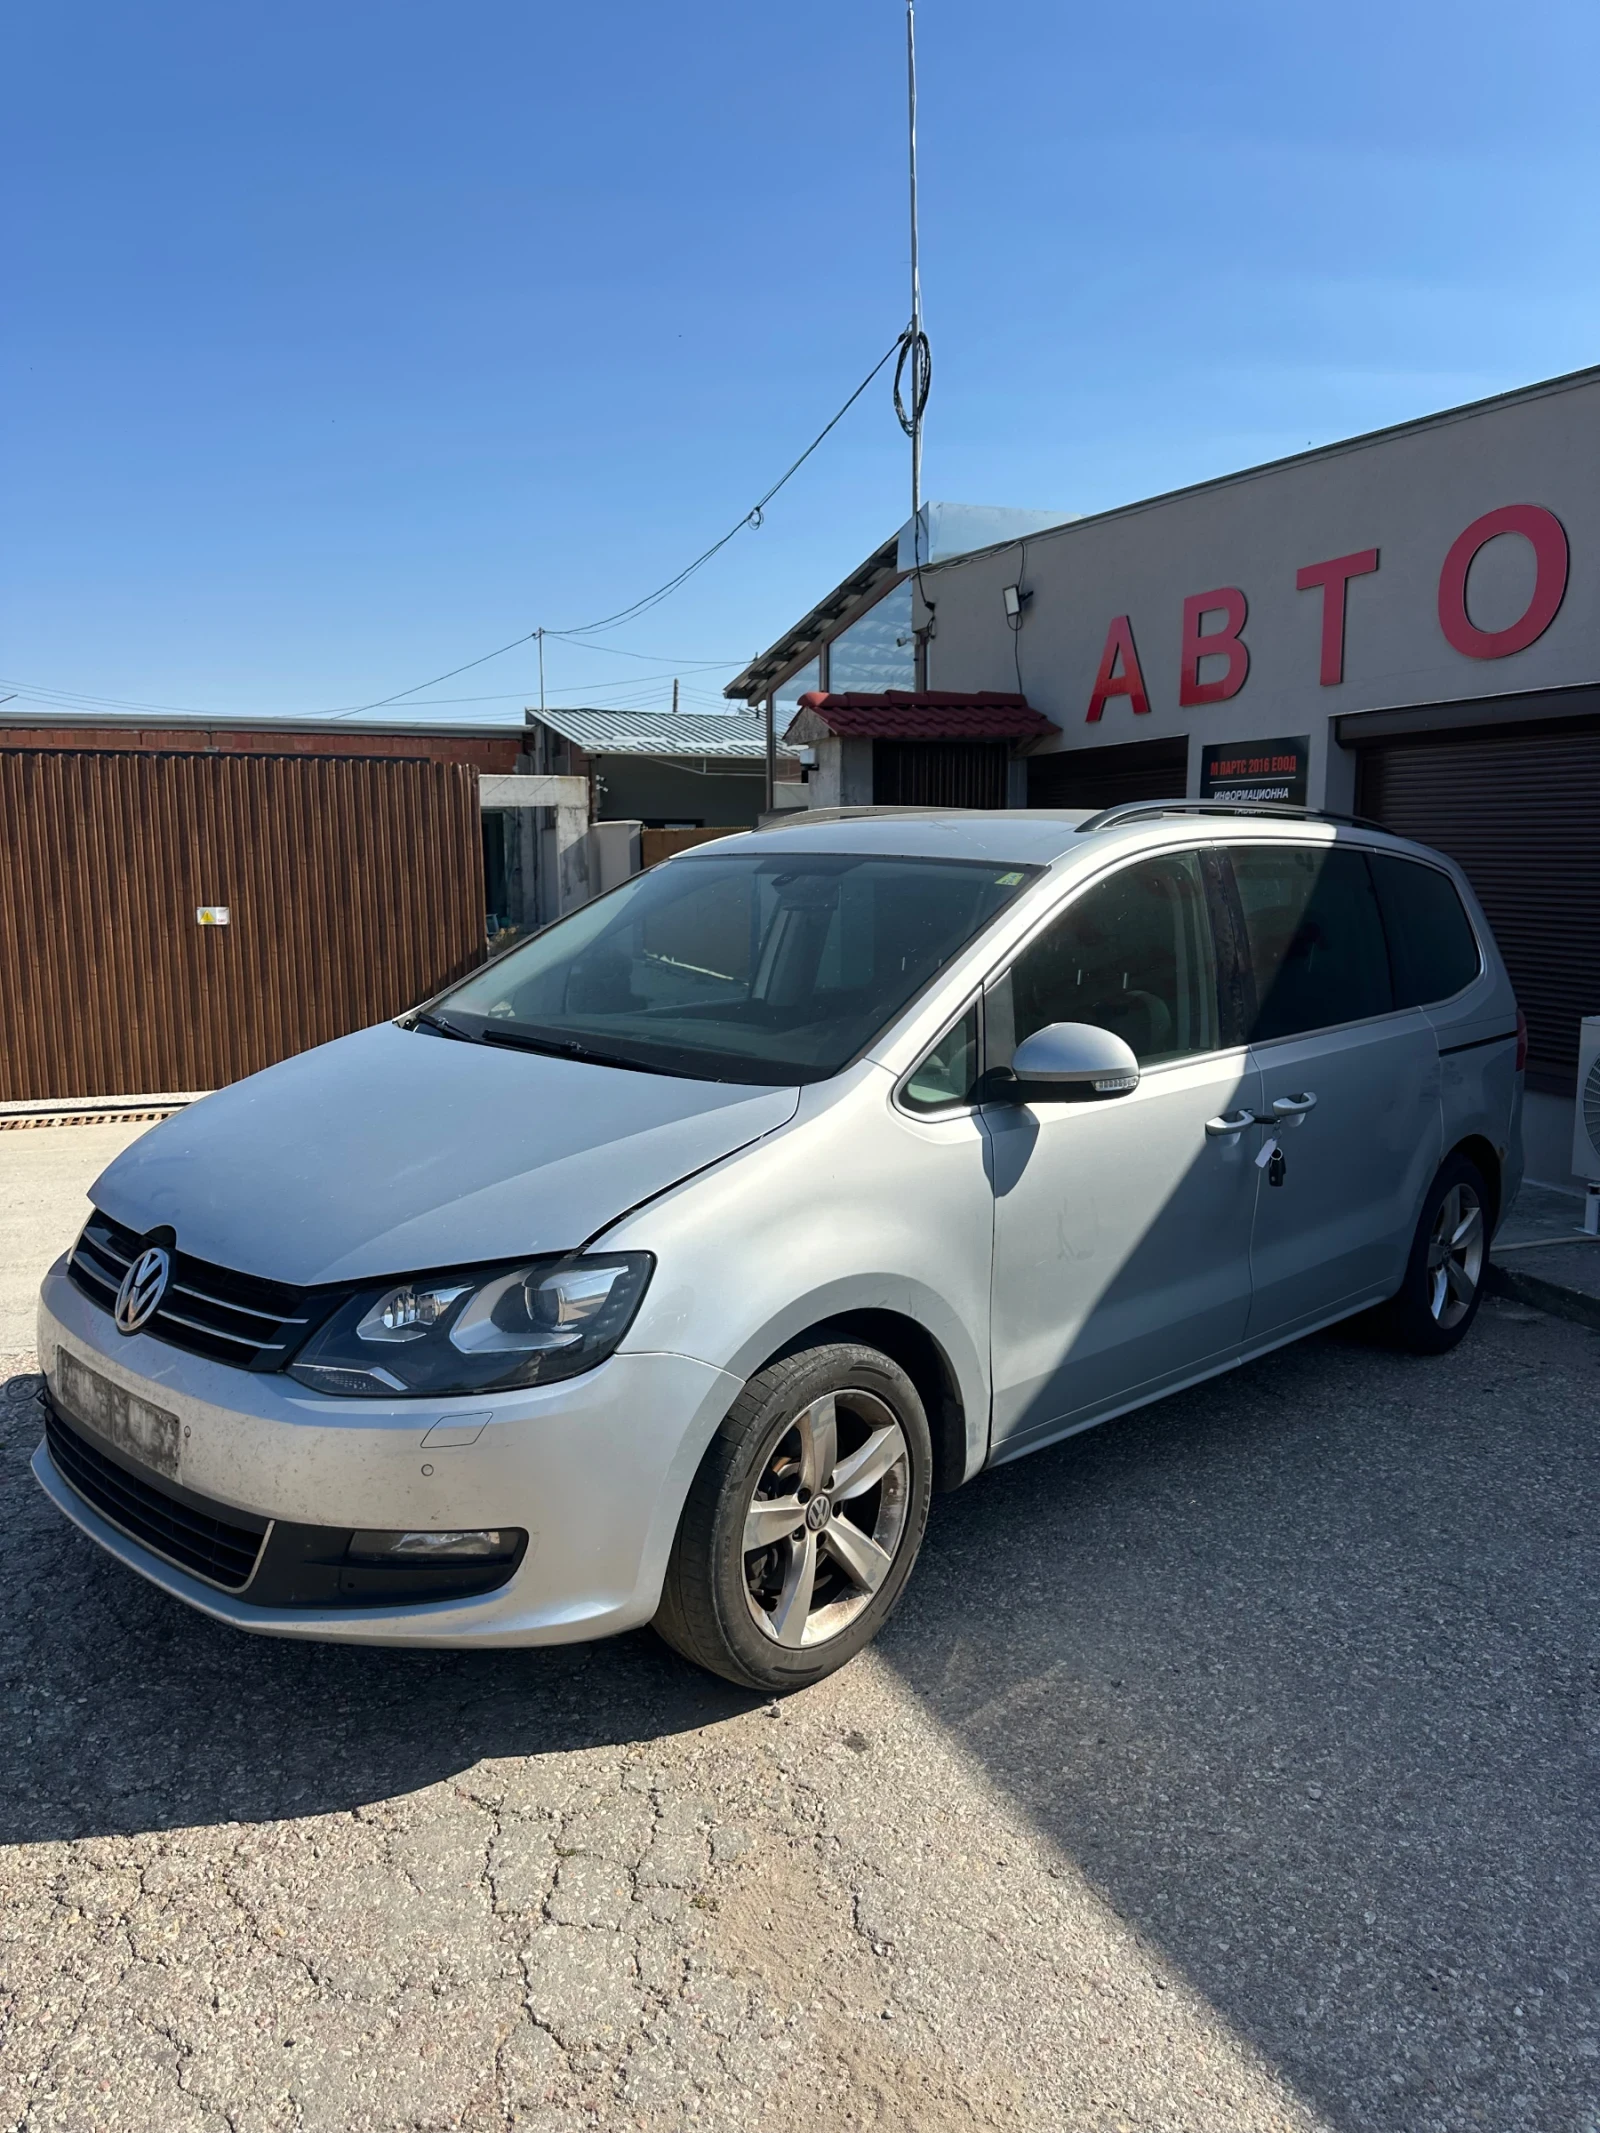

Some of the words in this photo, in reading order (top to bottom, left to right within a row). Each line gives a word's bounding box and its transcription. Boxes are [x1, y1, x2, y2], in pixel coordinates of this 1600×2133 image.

[1085, 504, 1570, 723] АВТО
[1220, 760, 1247, 775] ПАРТС
[1248, 758, 1268, 773] 2016
[1271, 756, 1296, 772] ЕООД
[1214, 788, 1288, 801] ИНФОРМАЦИОННА
